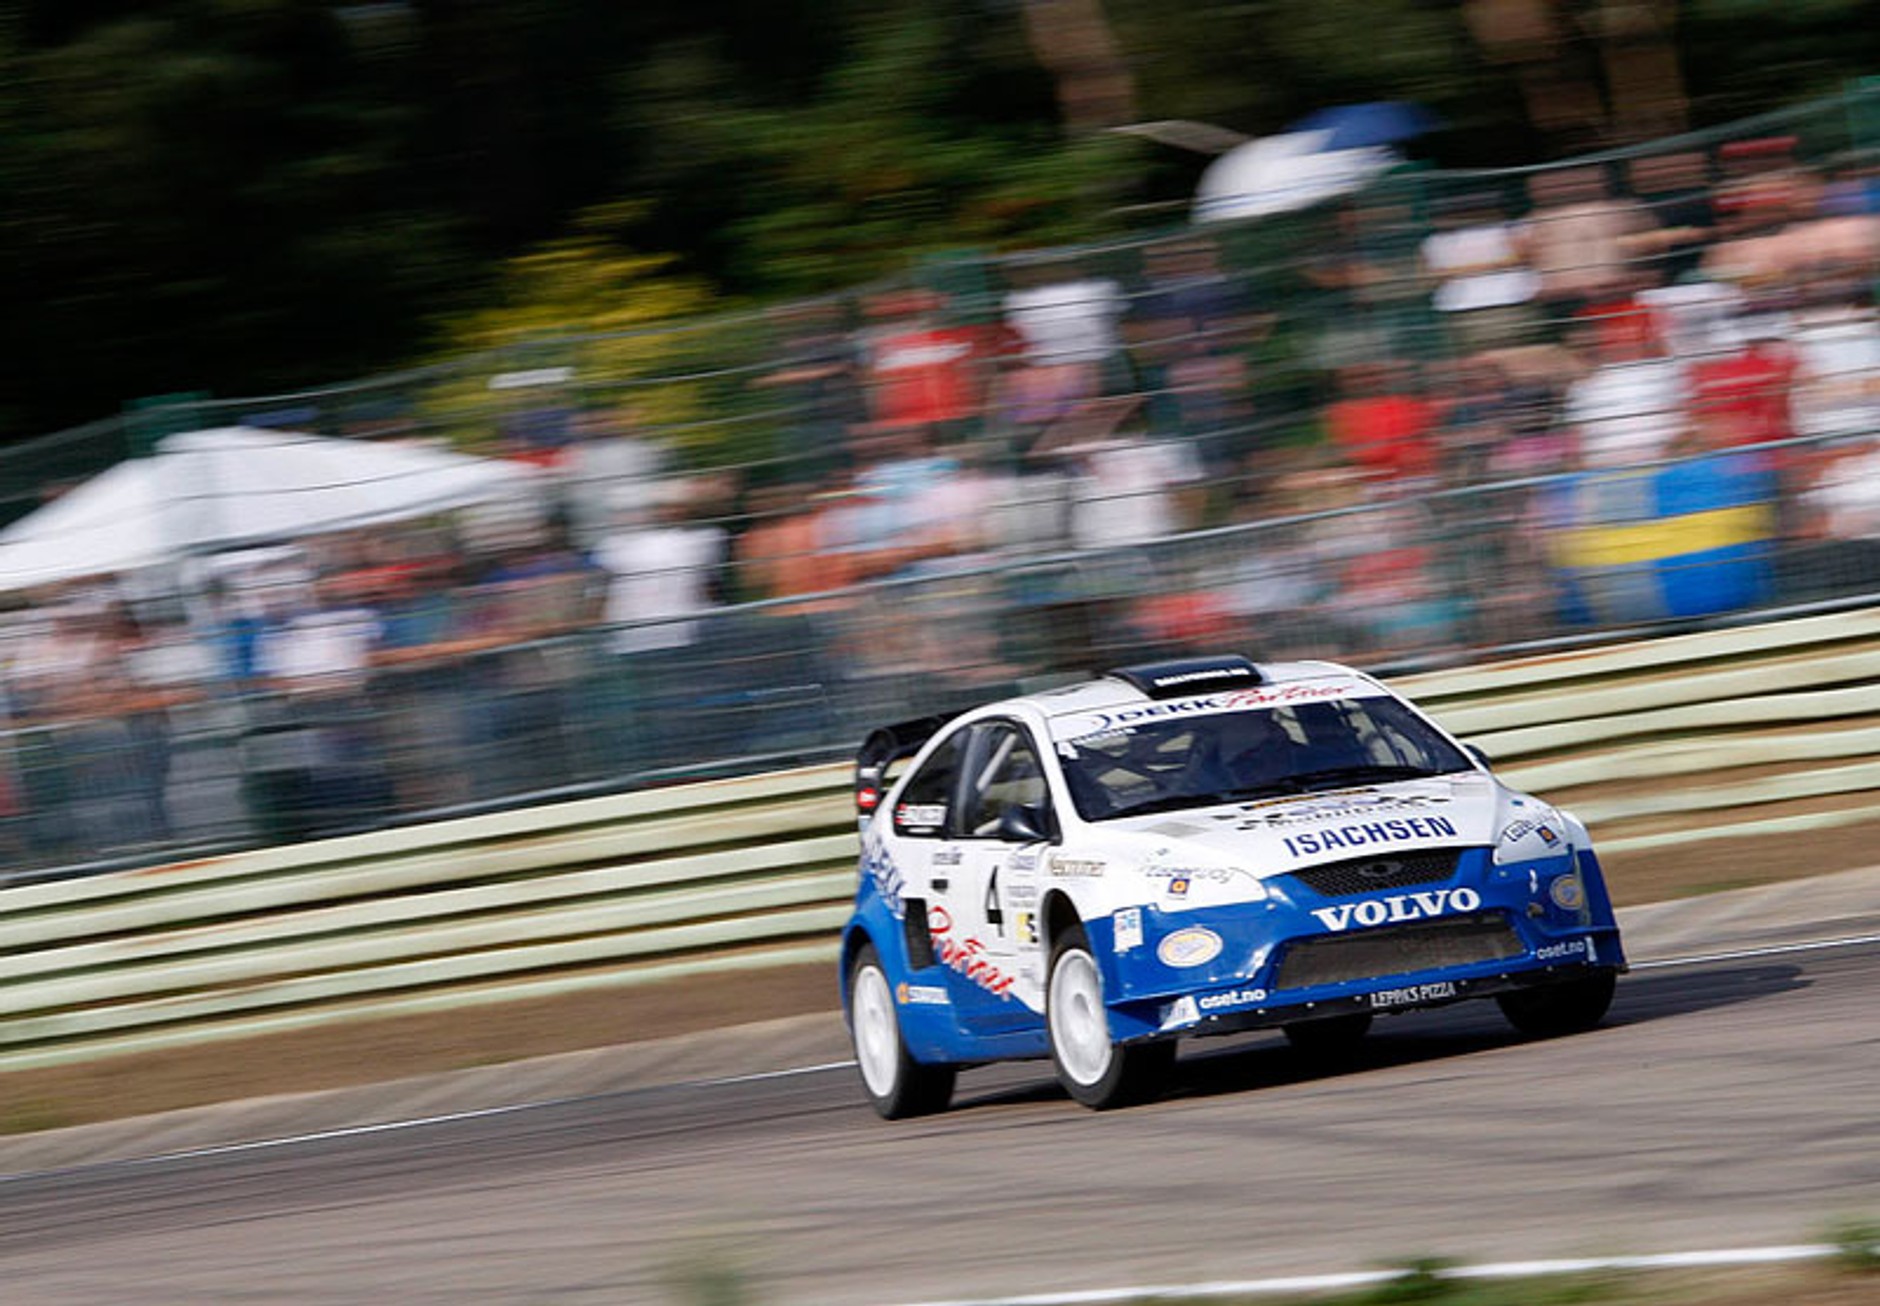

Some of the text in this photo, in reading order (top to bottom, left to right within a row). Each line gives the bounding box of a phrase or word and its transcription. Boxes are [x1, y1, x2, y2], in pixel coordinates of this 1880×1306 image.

[1115, 698, 1220, 722] DEKK
[1283, 816, 1457, 858] ISACHSEN
[985, 865, 1004, 938] 4
[1310, 888, 1481, 932] VOLVO
[1420, 982, 1457, 1001] PIZZA
